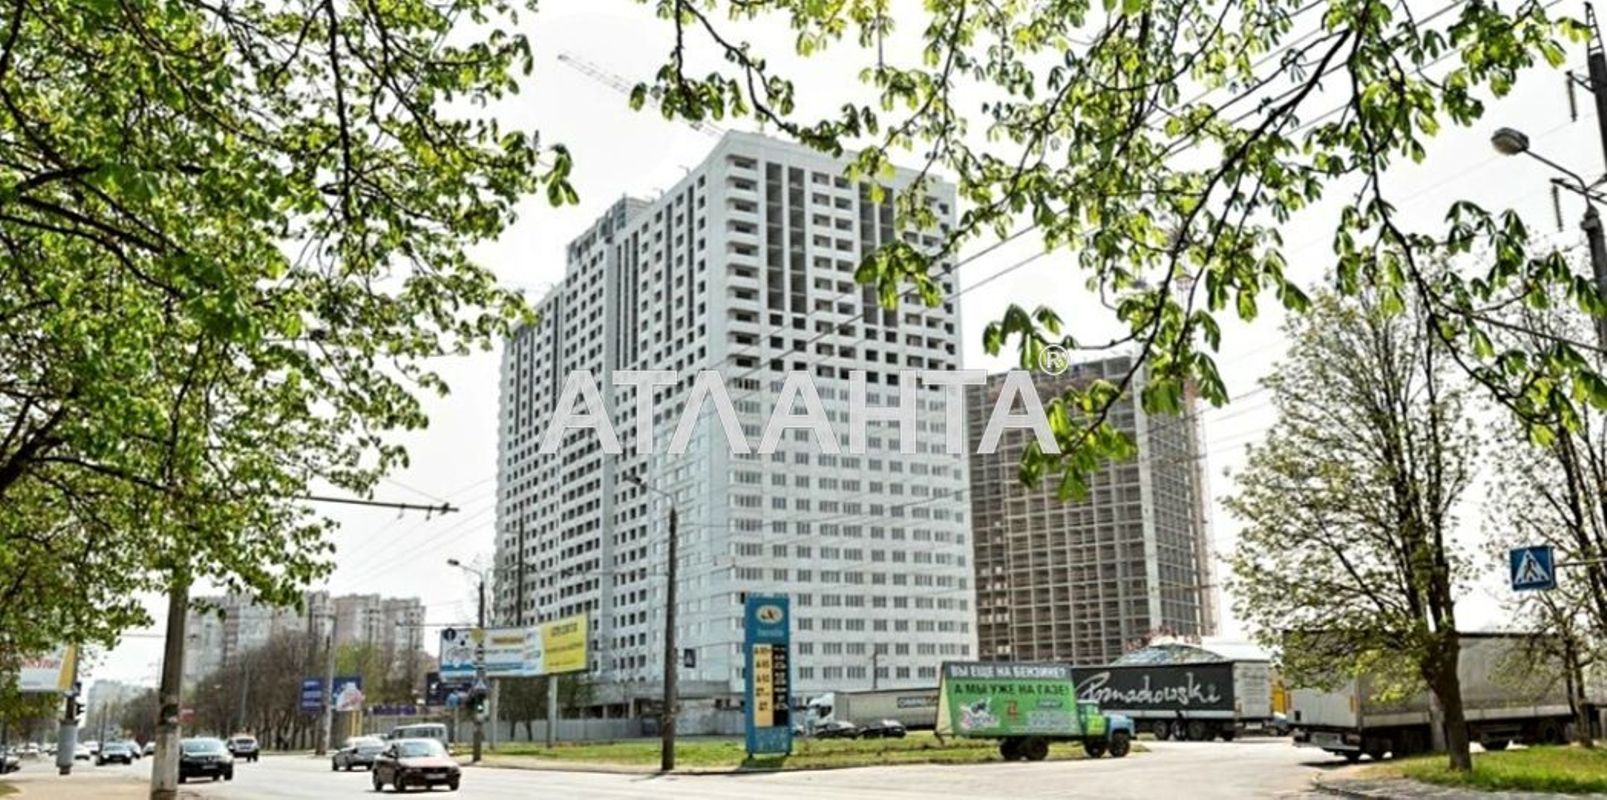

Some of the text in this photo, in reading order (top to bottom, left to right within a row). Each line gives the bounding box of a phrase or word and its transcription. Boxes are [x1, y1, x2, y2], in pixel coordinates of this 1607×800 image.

[950, 664, 1067, 679] ВЫ ЕЩЕ НА БЕНЗИНЕ?
[955, 684, 1070, 696] А МЫ УЖЕ НА ГАЗЕ!
